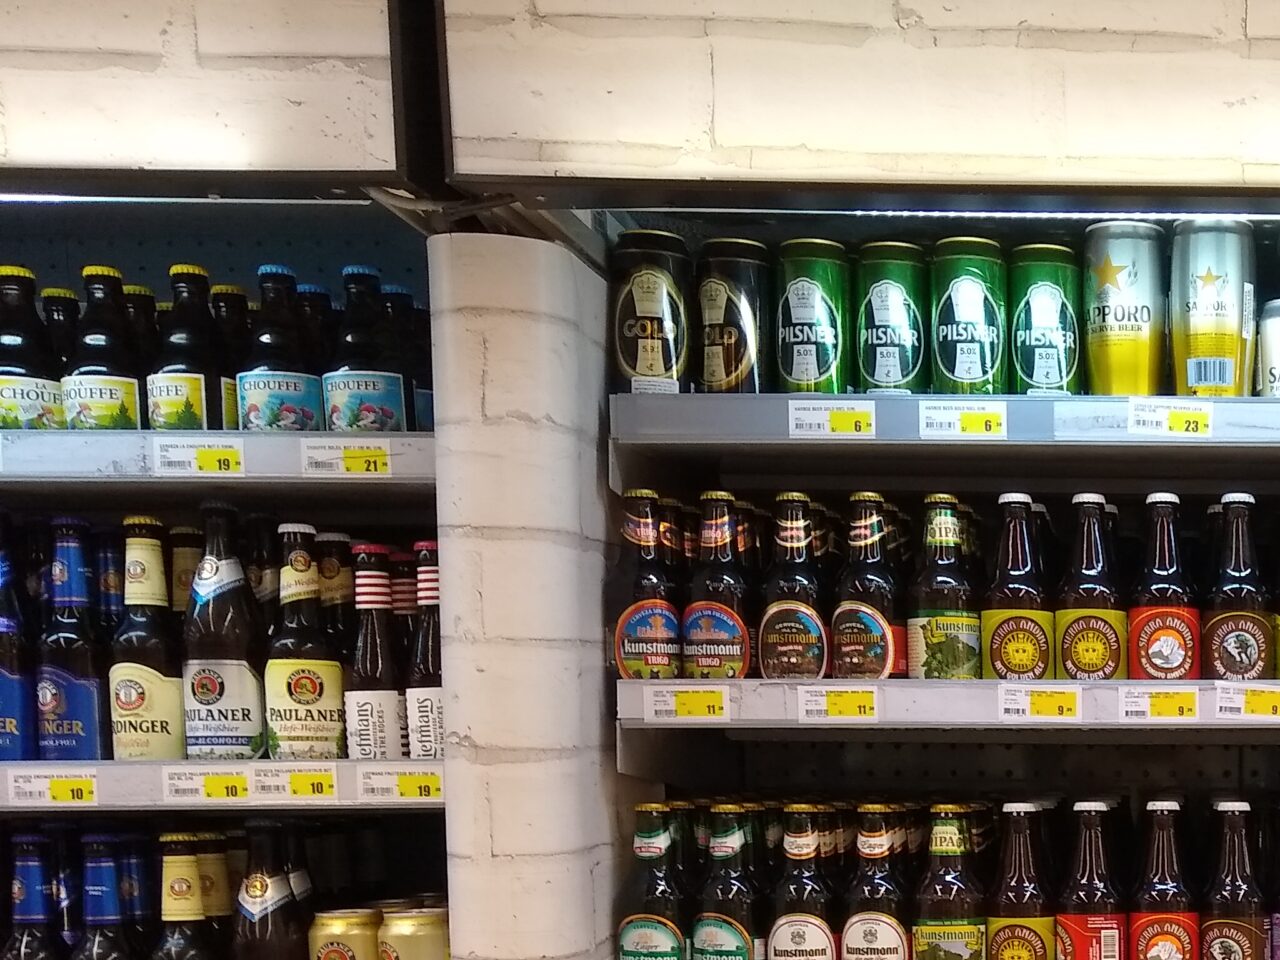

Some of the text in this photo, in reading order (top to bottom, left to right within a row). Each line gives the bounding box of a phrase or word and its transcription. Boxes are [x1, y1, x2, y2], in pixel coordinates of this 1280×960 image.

[939, 324, 998, 343] PILSNER
[1119, 324, 1143, 332] BEER
[779, 326, 836, 344] PILSNER
[860, 328, 918, 347] PILSNER
[1017, 329, 1075, 348] PILSNER
[243, 381, 301, 391] CHOUFFE
[1185, 420, 1199, 432] 23
[218, 458, 231, 471] 19
[365, 460, 377, 471] 21
[992, 617, 1047, 650] SIERRA ANDINA
[1063, 618, 1118, 650] SIERRA ANDINA
[647, 656, 669, 665] TRIGO
[698, 657, 720, 666] TRIGO
[270, 708, 343, 722] PAULANER
[70, 789, 83, 799] 10
[225, 785, 237, 796] 10
[311, 783, 323, 793] 10
[418, 785, 430, 796] 19
[920, 929, 976, 941] kunstmann
[991, 927, 1044, 956] SIERRA ANDINA
[773, 947, 827, 958] kunstmann
[846, 944, 899, 956] kunstmann
